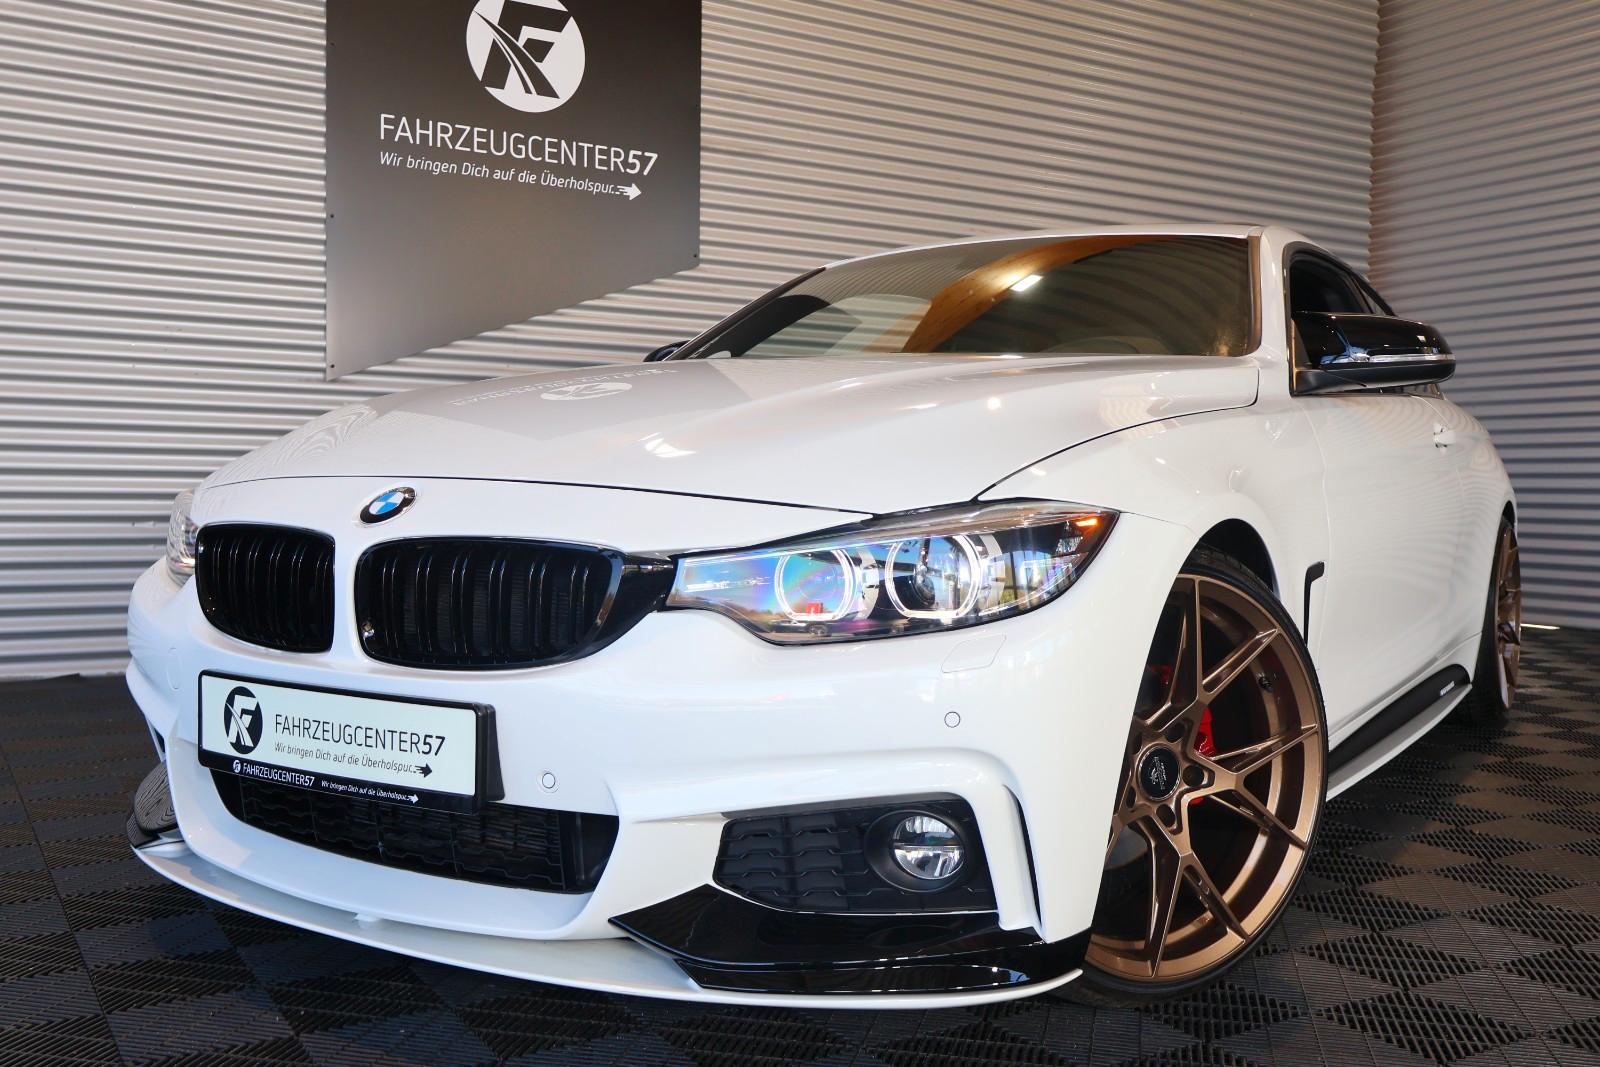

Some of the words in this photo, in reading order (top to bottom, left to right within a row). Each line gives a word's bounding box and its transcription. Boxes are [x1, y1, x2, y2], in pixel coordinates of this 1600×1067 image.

[380, 113, 658, 176] FAHRZEUGCENTER57
[380, 151, 403, 167] Wir
[406, 155, 457, 175] bringen
[461, 162, 489, 178] Dich
[493, 168, 515, 181] auf
[518, 170, 537, 184] die
[275, 713, 446, 756] FAHRZEUGCENTER57
[274, 742, 286, 753] Wir
[287, 744, 314, 760] bringen
[315, 748, 331, 761] Dich
[333, 753, 346, 763] auf
[348, 754, 360, 766] die
[243, 762, 315, 787] FAHRZEUGCENTER57
[330, 781, 348, 791] bringen
[347, 784, 359, 793] Dich
[359, 787, 368, 795] auf
[367, 788, 376, 796] die
